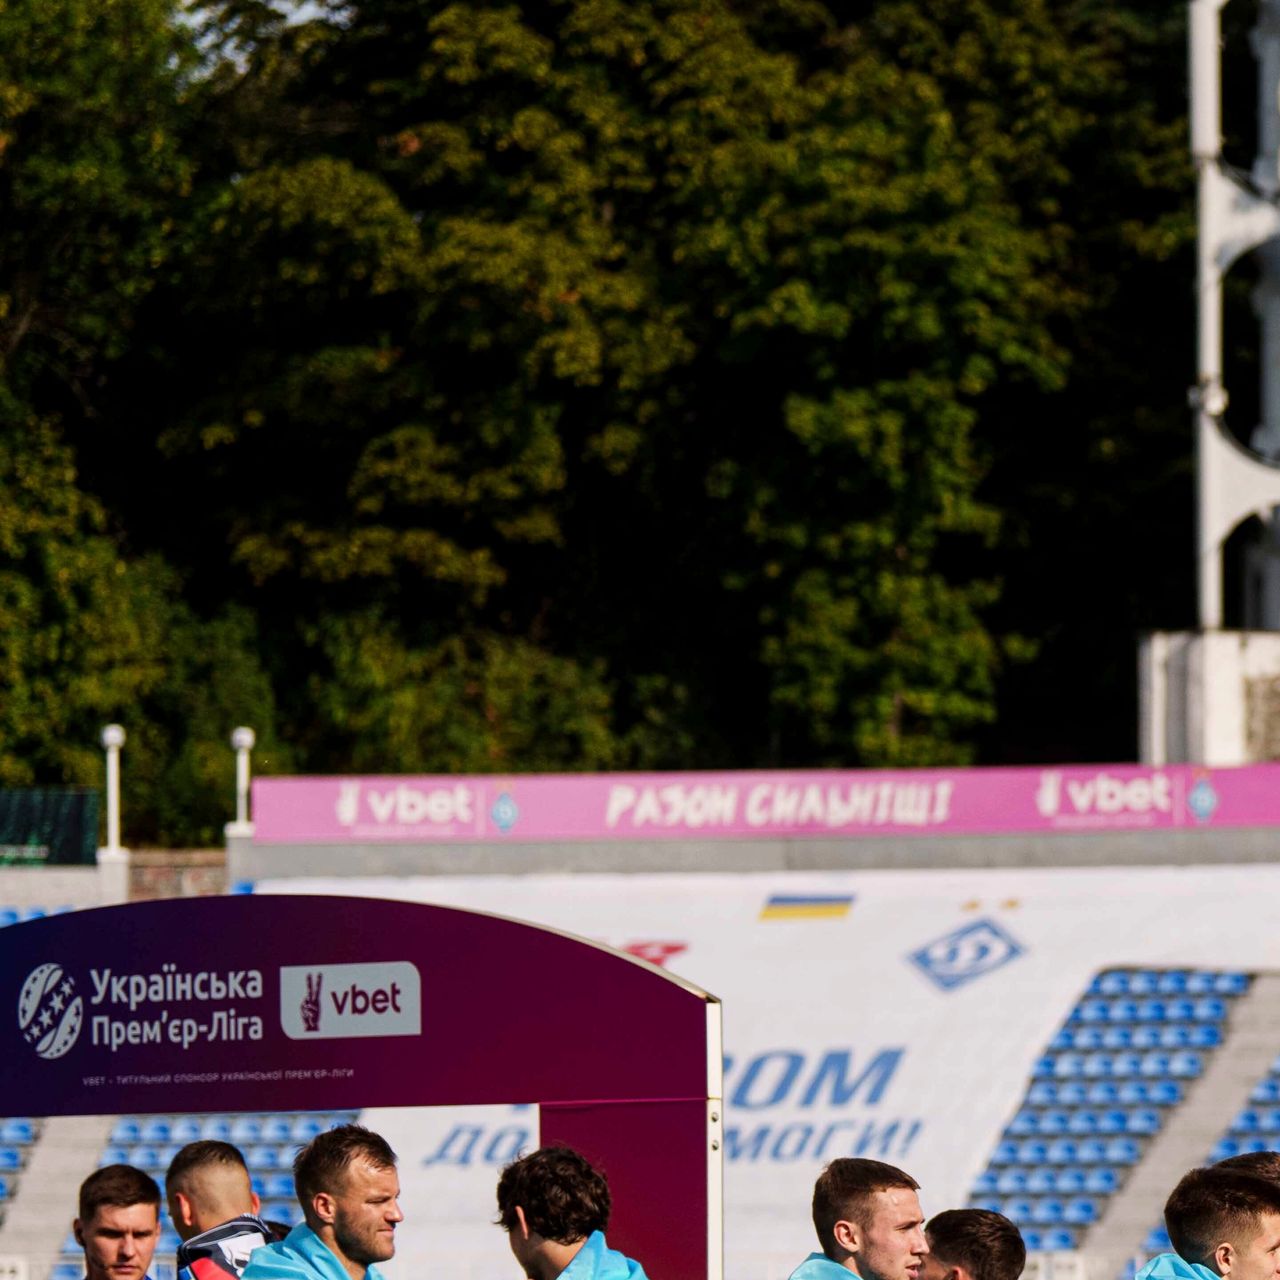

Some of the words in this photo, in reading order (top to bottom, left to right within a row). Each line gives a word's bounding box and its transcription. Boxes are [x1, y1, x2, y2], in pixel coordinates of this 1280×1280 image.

[366, 783, 474, 824] vbet
[1066, 771, 1172, 814] vbet
[90, 963, 263, 1010] Українська
[330, 981, 402, 1016] vbet
[91, 1009, 264, 1051] Прем'єр-Ліга
